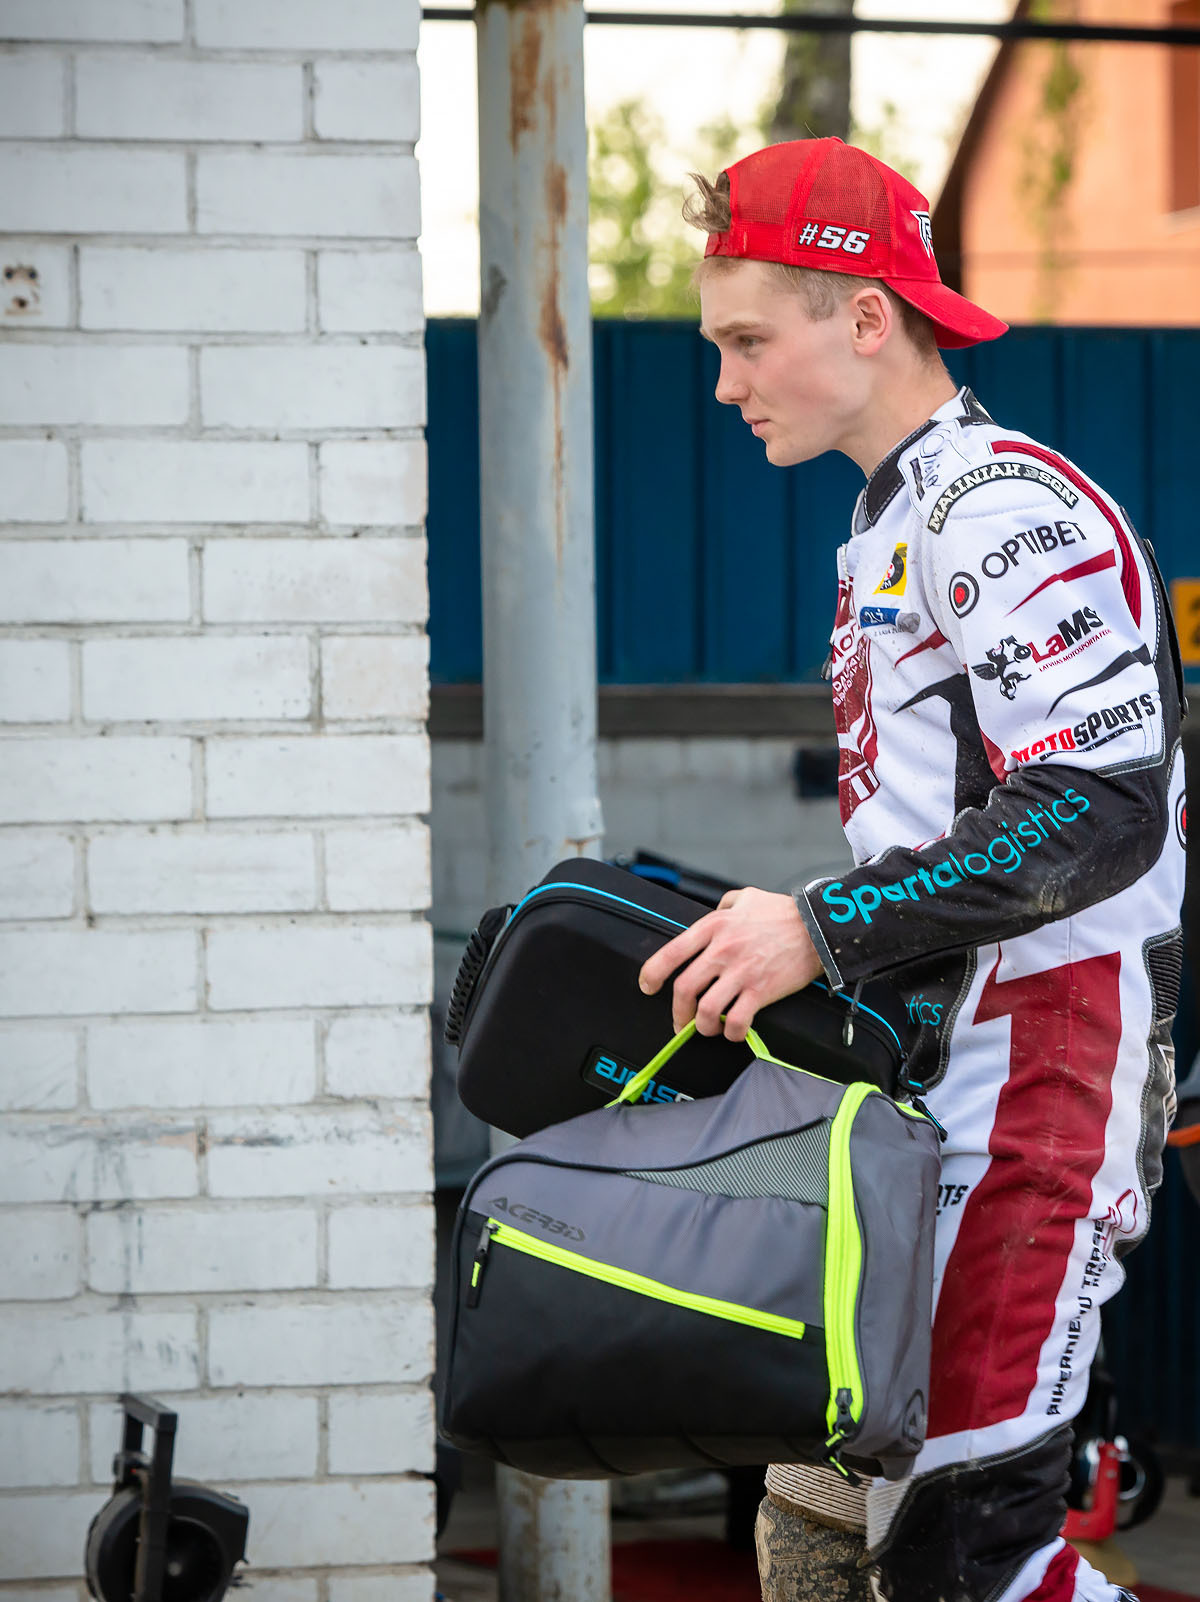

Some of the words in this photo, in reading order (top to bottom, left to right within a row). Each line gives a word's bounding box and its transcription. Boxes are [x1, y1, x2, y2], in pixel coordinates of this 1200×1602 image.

[799, 222, 870, 255] #56
[982, 520, 1087, 578] OPTIBET
[1027, 606, 1103, 664] LaMS
[1011, 693, 1156, 763] MOTOSPORTS
[822, 788, 1090, 924] Spartalogistics
